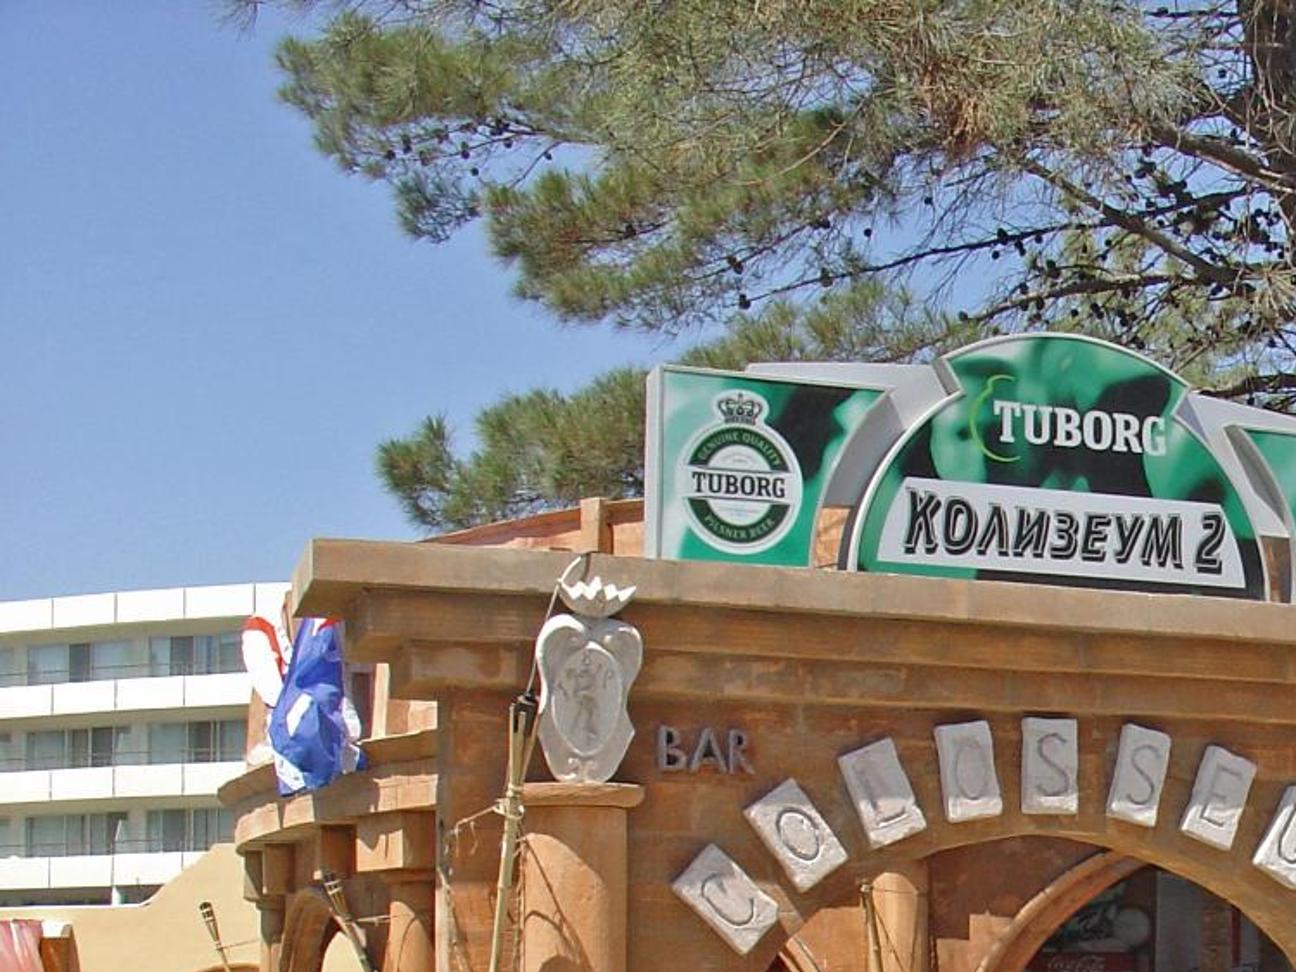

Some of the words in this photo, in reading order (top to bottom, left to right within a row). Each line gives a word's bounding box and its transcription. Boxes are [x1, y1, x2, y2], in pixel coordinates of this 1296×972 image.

[993, 400, 1167, 456] TUBORG
[692, 471, 786, 498] TUBORG
[904, 487, 1183, 569] КОЛИЗЕУМ
[1195, 511, 1226, 574] 2
[656, 724, 755, 776] BAR
